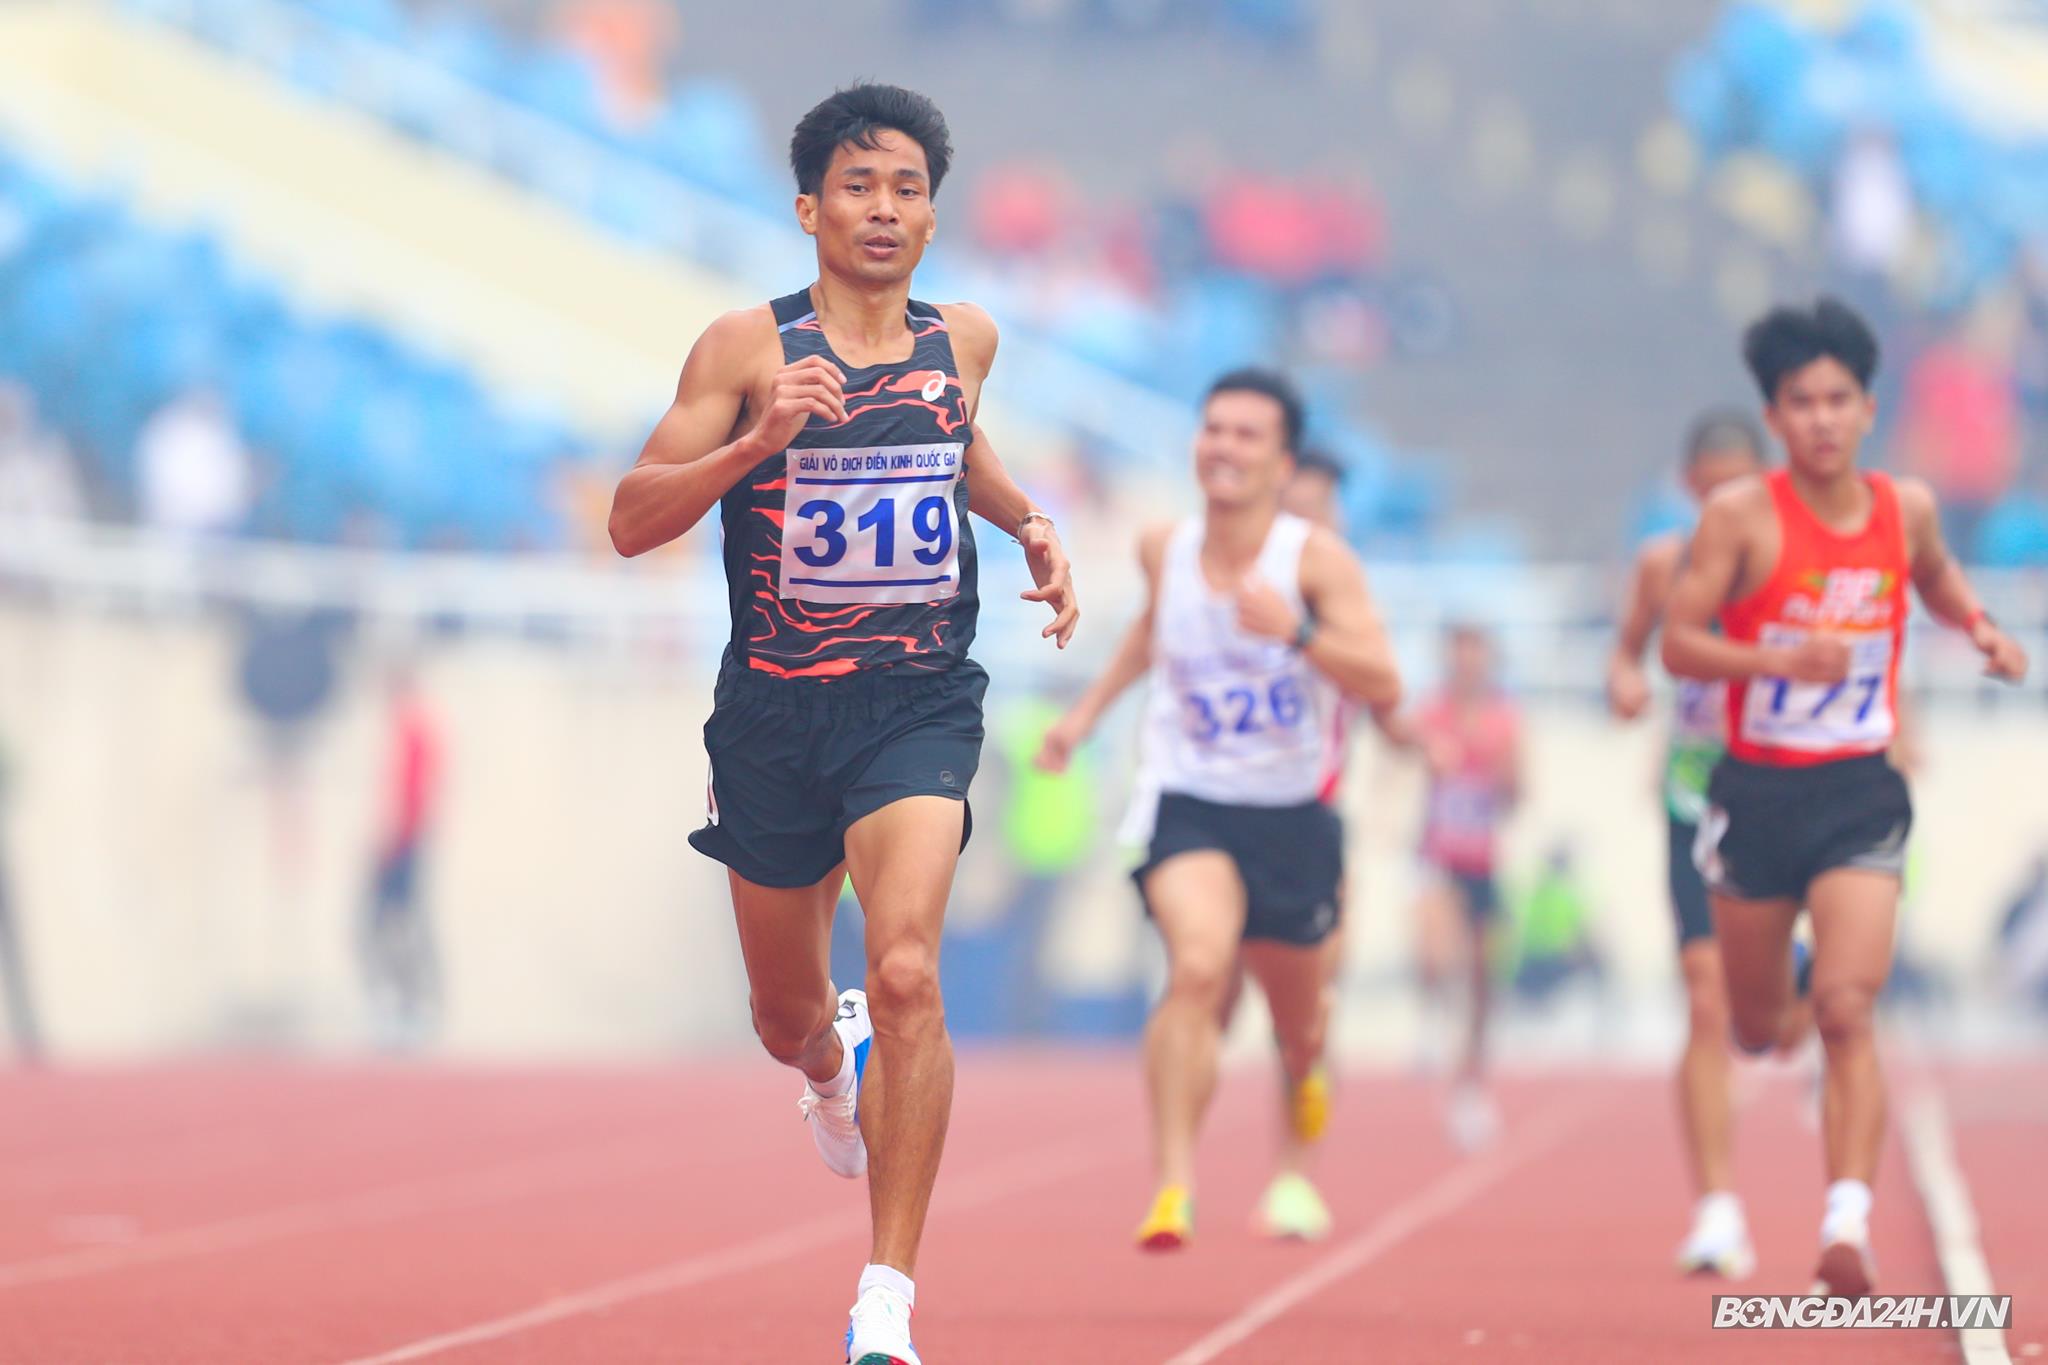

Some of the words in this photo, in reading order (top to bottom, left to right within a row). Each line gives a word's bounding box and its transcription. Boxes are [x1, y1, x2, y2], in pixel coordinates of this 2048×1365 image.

[800, 453, 819, 471] GIẢI
[890, 454, 913, 470] KINH
[916, 448, 941, 468] QUỐC
[944, 452, 956, 466] GIA
[793, 496, 953, 568] 319
[1187, 674, 1304, 742] 326
